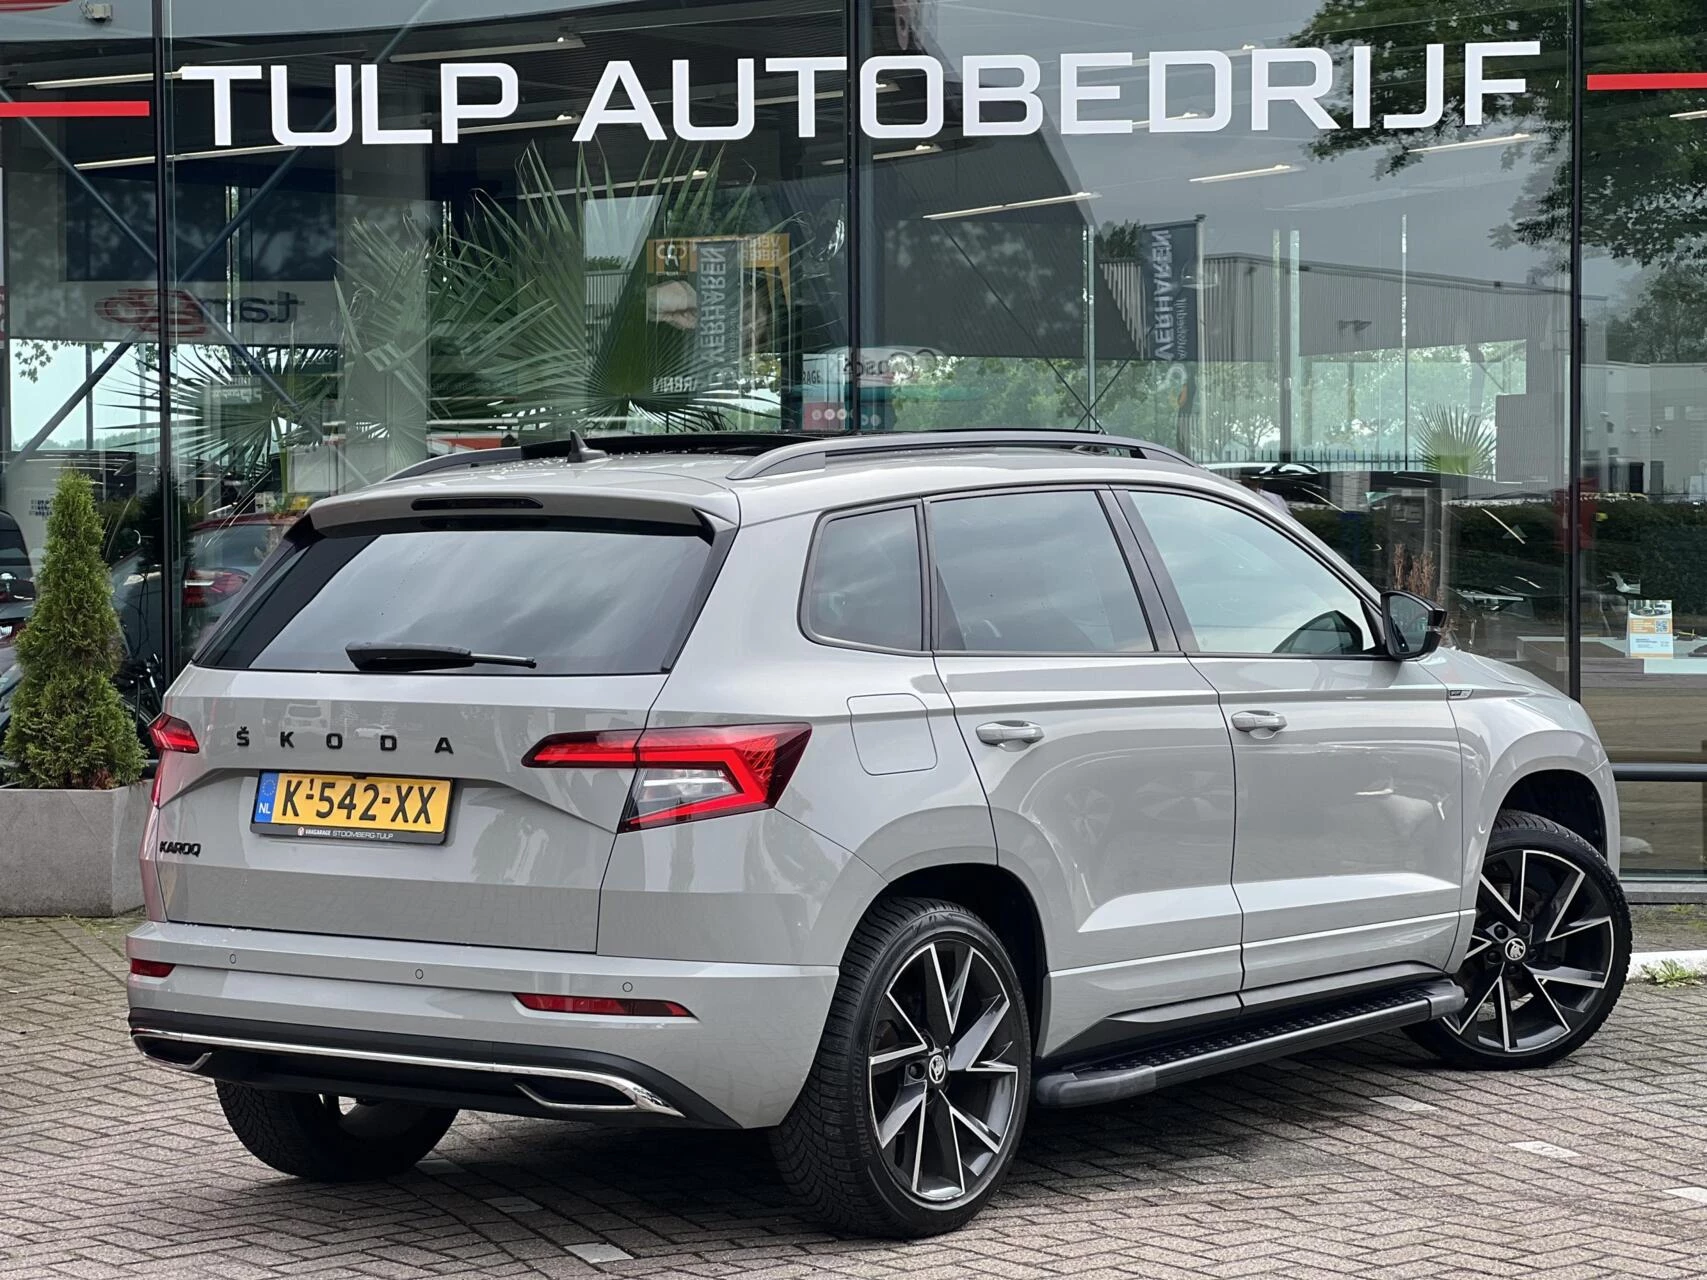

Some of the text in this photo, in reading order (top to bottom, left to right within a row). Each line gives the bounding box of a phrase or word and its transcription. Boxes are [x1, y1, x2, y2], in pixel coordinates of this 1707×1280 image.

[181, 40, 1541, 146] TULP AUTOBEDRIJF
[236, 726, 454, 755] ŠKODA
[258, 802, 272, 815] NL
[281, 778, 437, 825] K-542-XX
[159, 840, 202, 858] KAROQ
